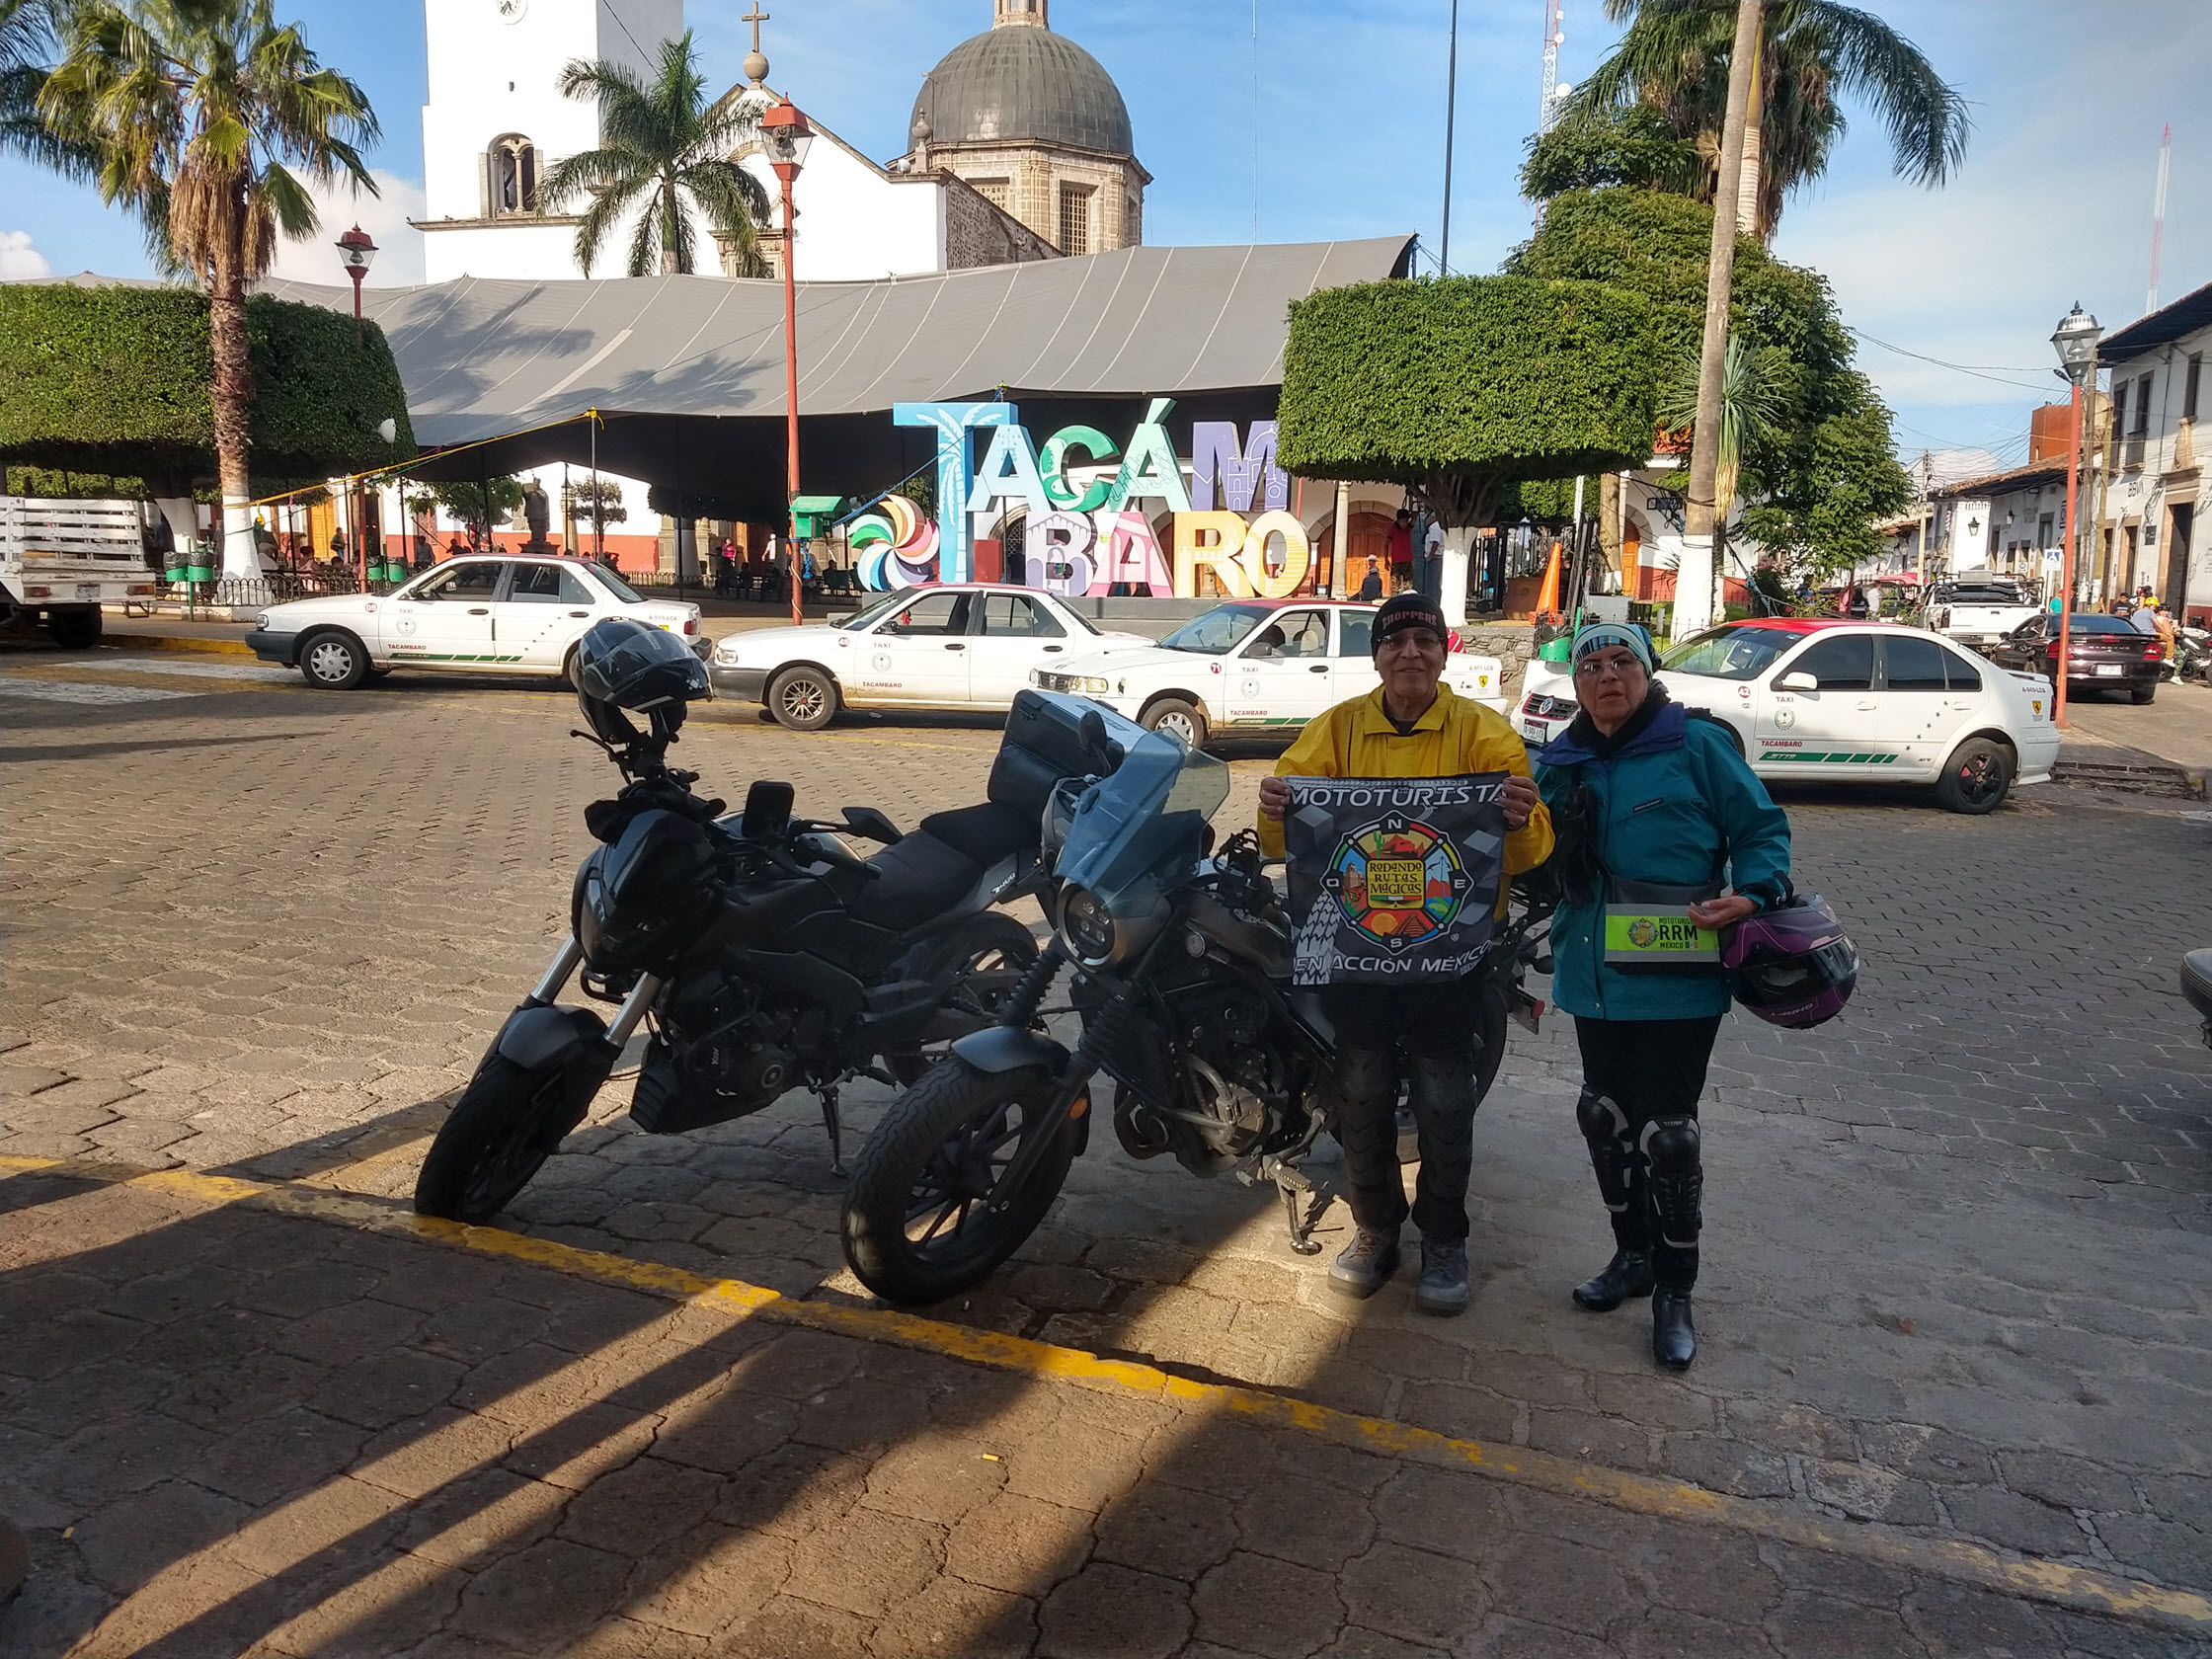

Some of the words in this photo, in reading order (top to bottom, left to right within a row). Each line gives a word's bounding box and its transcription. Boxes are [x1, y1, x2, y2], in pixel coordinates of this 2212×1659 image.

[894, 397, 1291, 585] TACÁM
[1025, 510, 1310, 597] BARO
[1382, 610, 1438, 630] CHOPPERS
[1288, 783, 1506, 808] MOTOTURISTA
[1387, 819, 1402, 830] N
[1454, 879, 1466, 889] E
[1659, 924, 1698, 941] RRM
[1389, 938, 1403, 949] S
[1296, 957, 1323, 971] EN
[1330, 955, 1413, 974] ACCIÓN
[1420, 939, 1492, 973] MÉXICO
